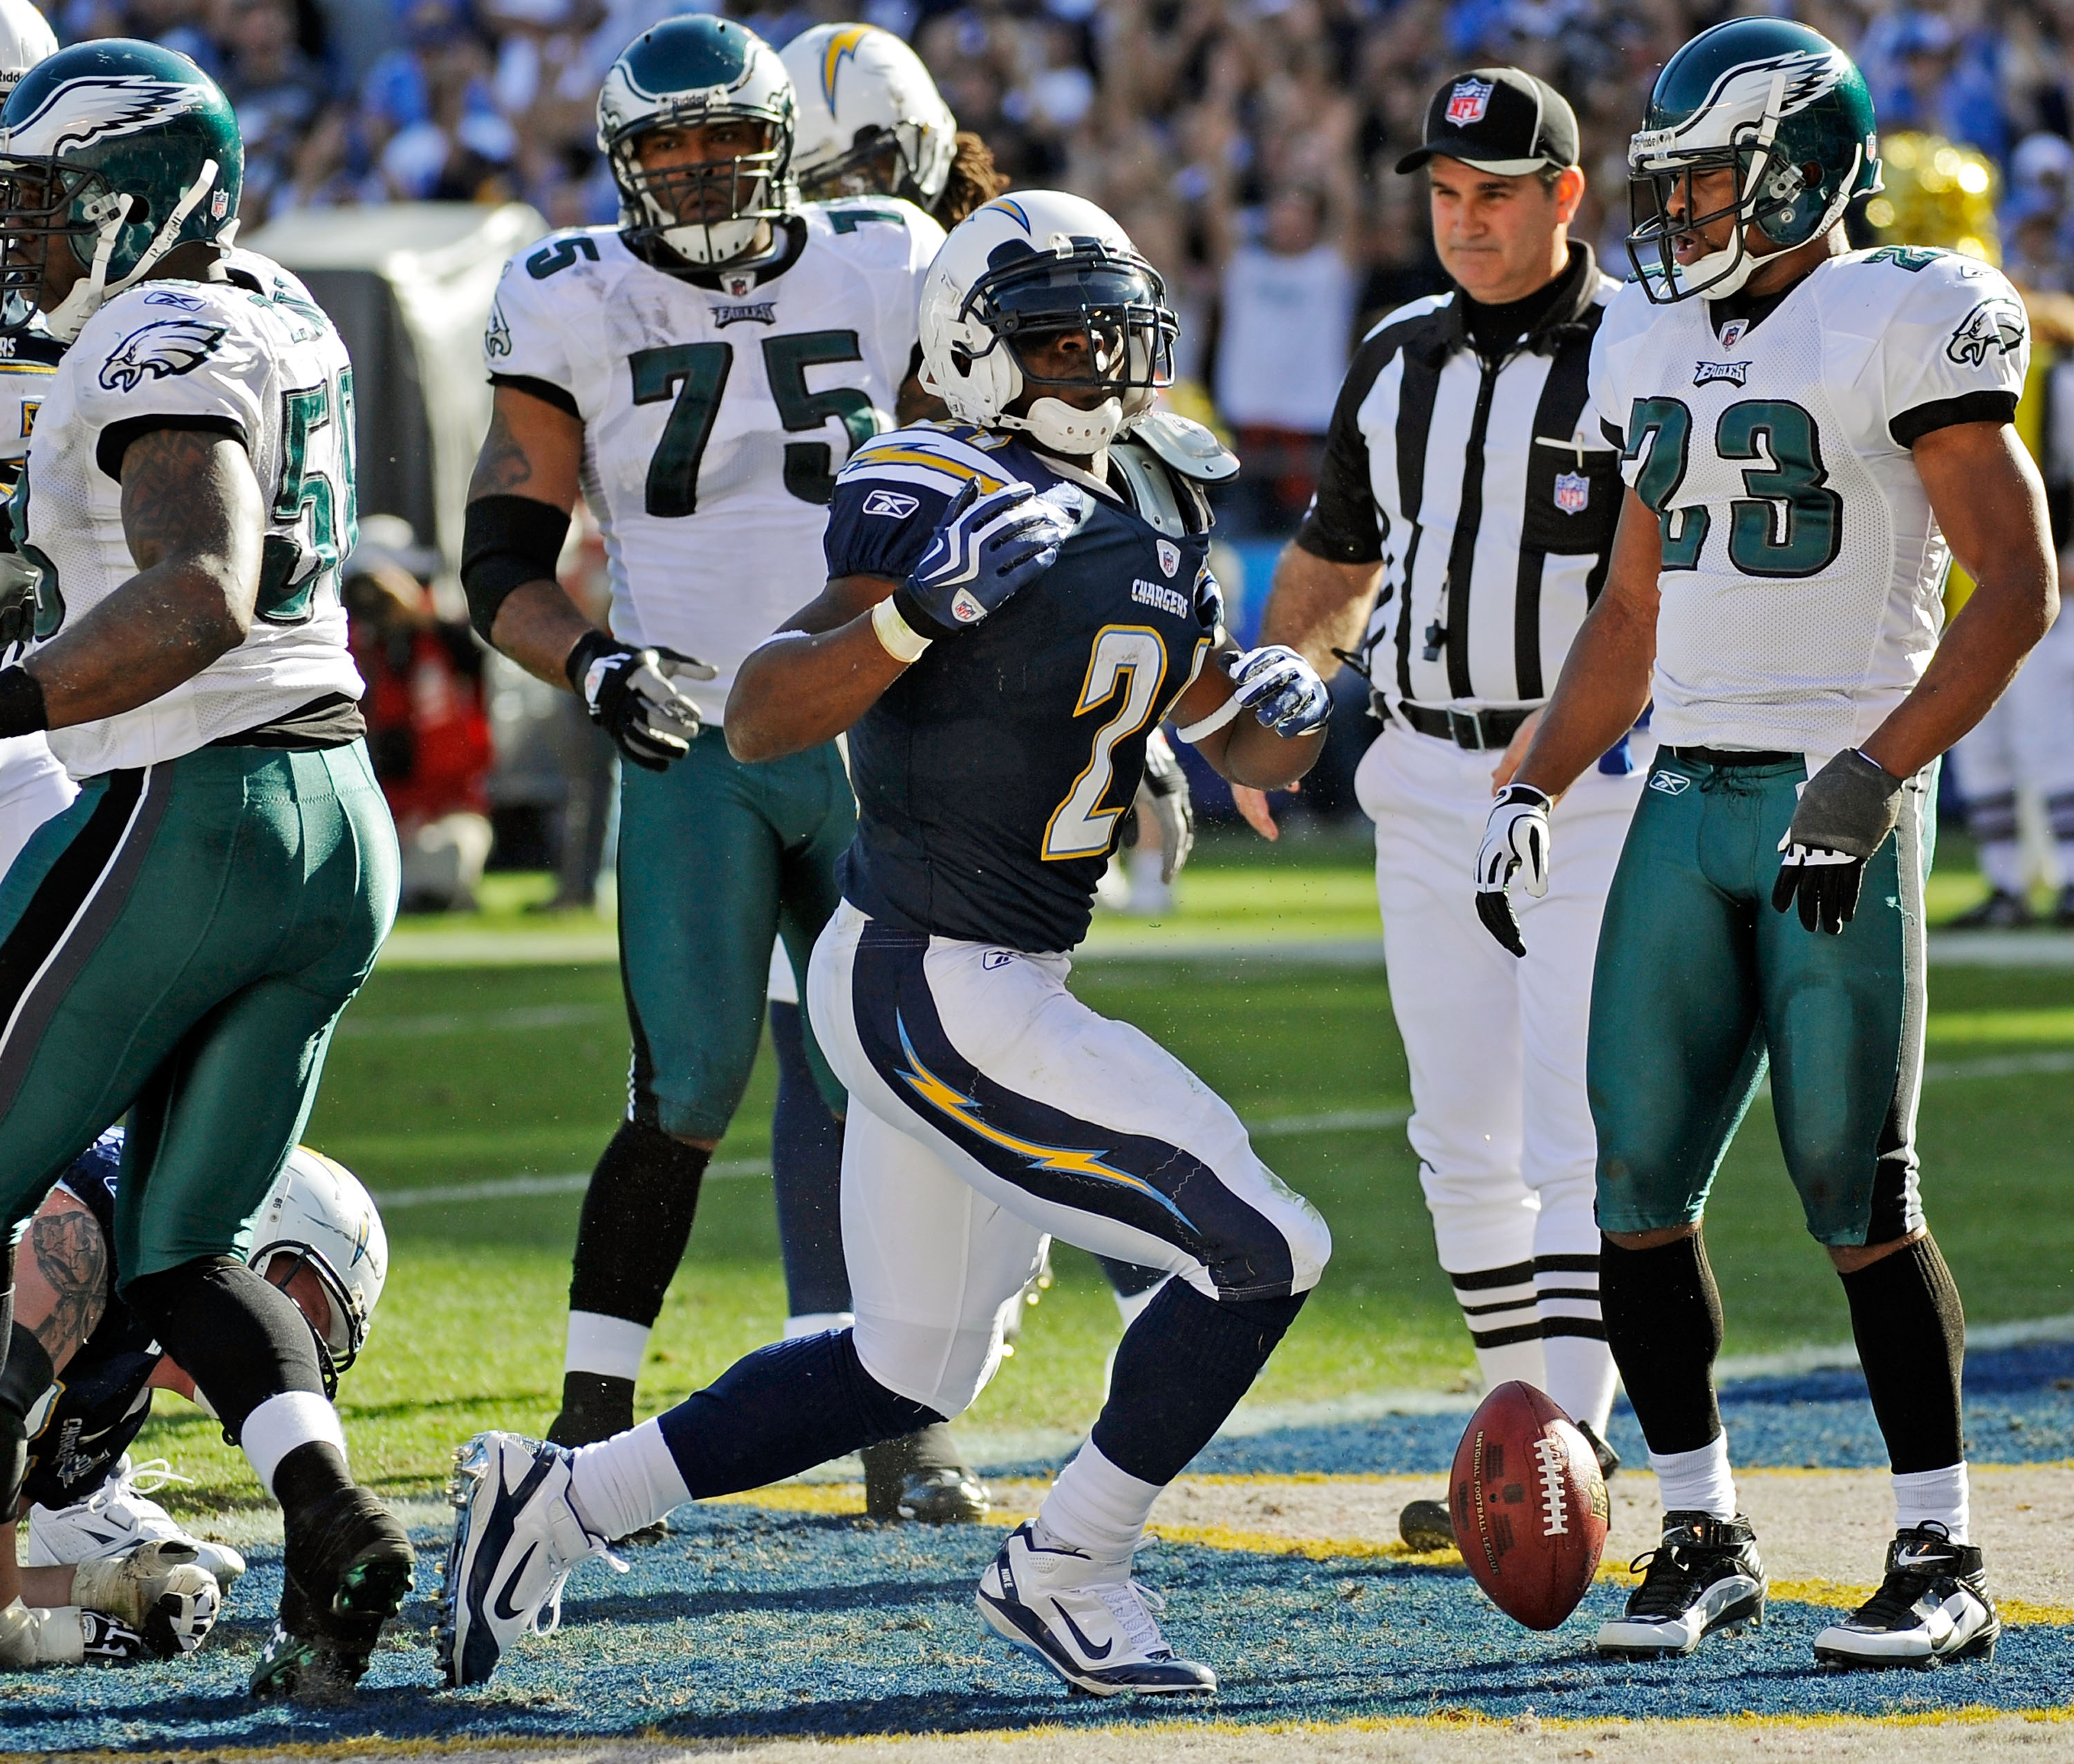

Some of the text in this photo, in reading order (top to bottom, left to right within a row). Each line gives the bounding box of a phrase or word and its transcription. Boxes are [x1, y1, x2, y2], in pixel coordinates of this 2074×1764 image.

[1448, 97, 1484, 120] NFL
[708, 302, 778, 330] EAGLES
[1692, 361, 1753, 388] EAGLES
[628, 329, 876, 518] 75
[1558, 488, 1585, 507] NFL
[1622, 396, 1844, 579] 23
[956, 604, 972, 620] NFL
[1131, 579, 1189, 619] CHARGERS
[1473, 1430, 1501, 1576] NATIONAL FOOTBALL LEAGUE
[1001, 1568, 1014, 1589] NIKE
